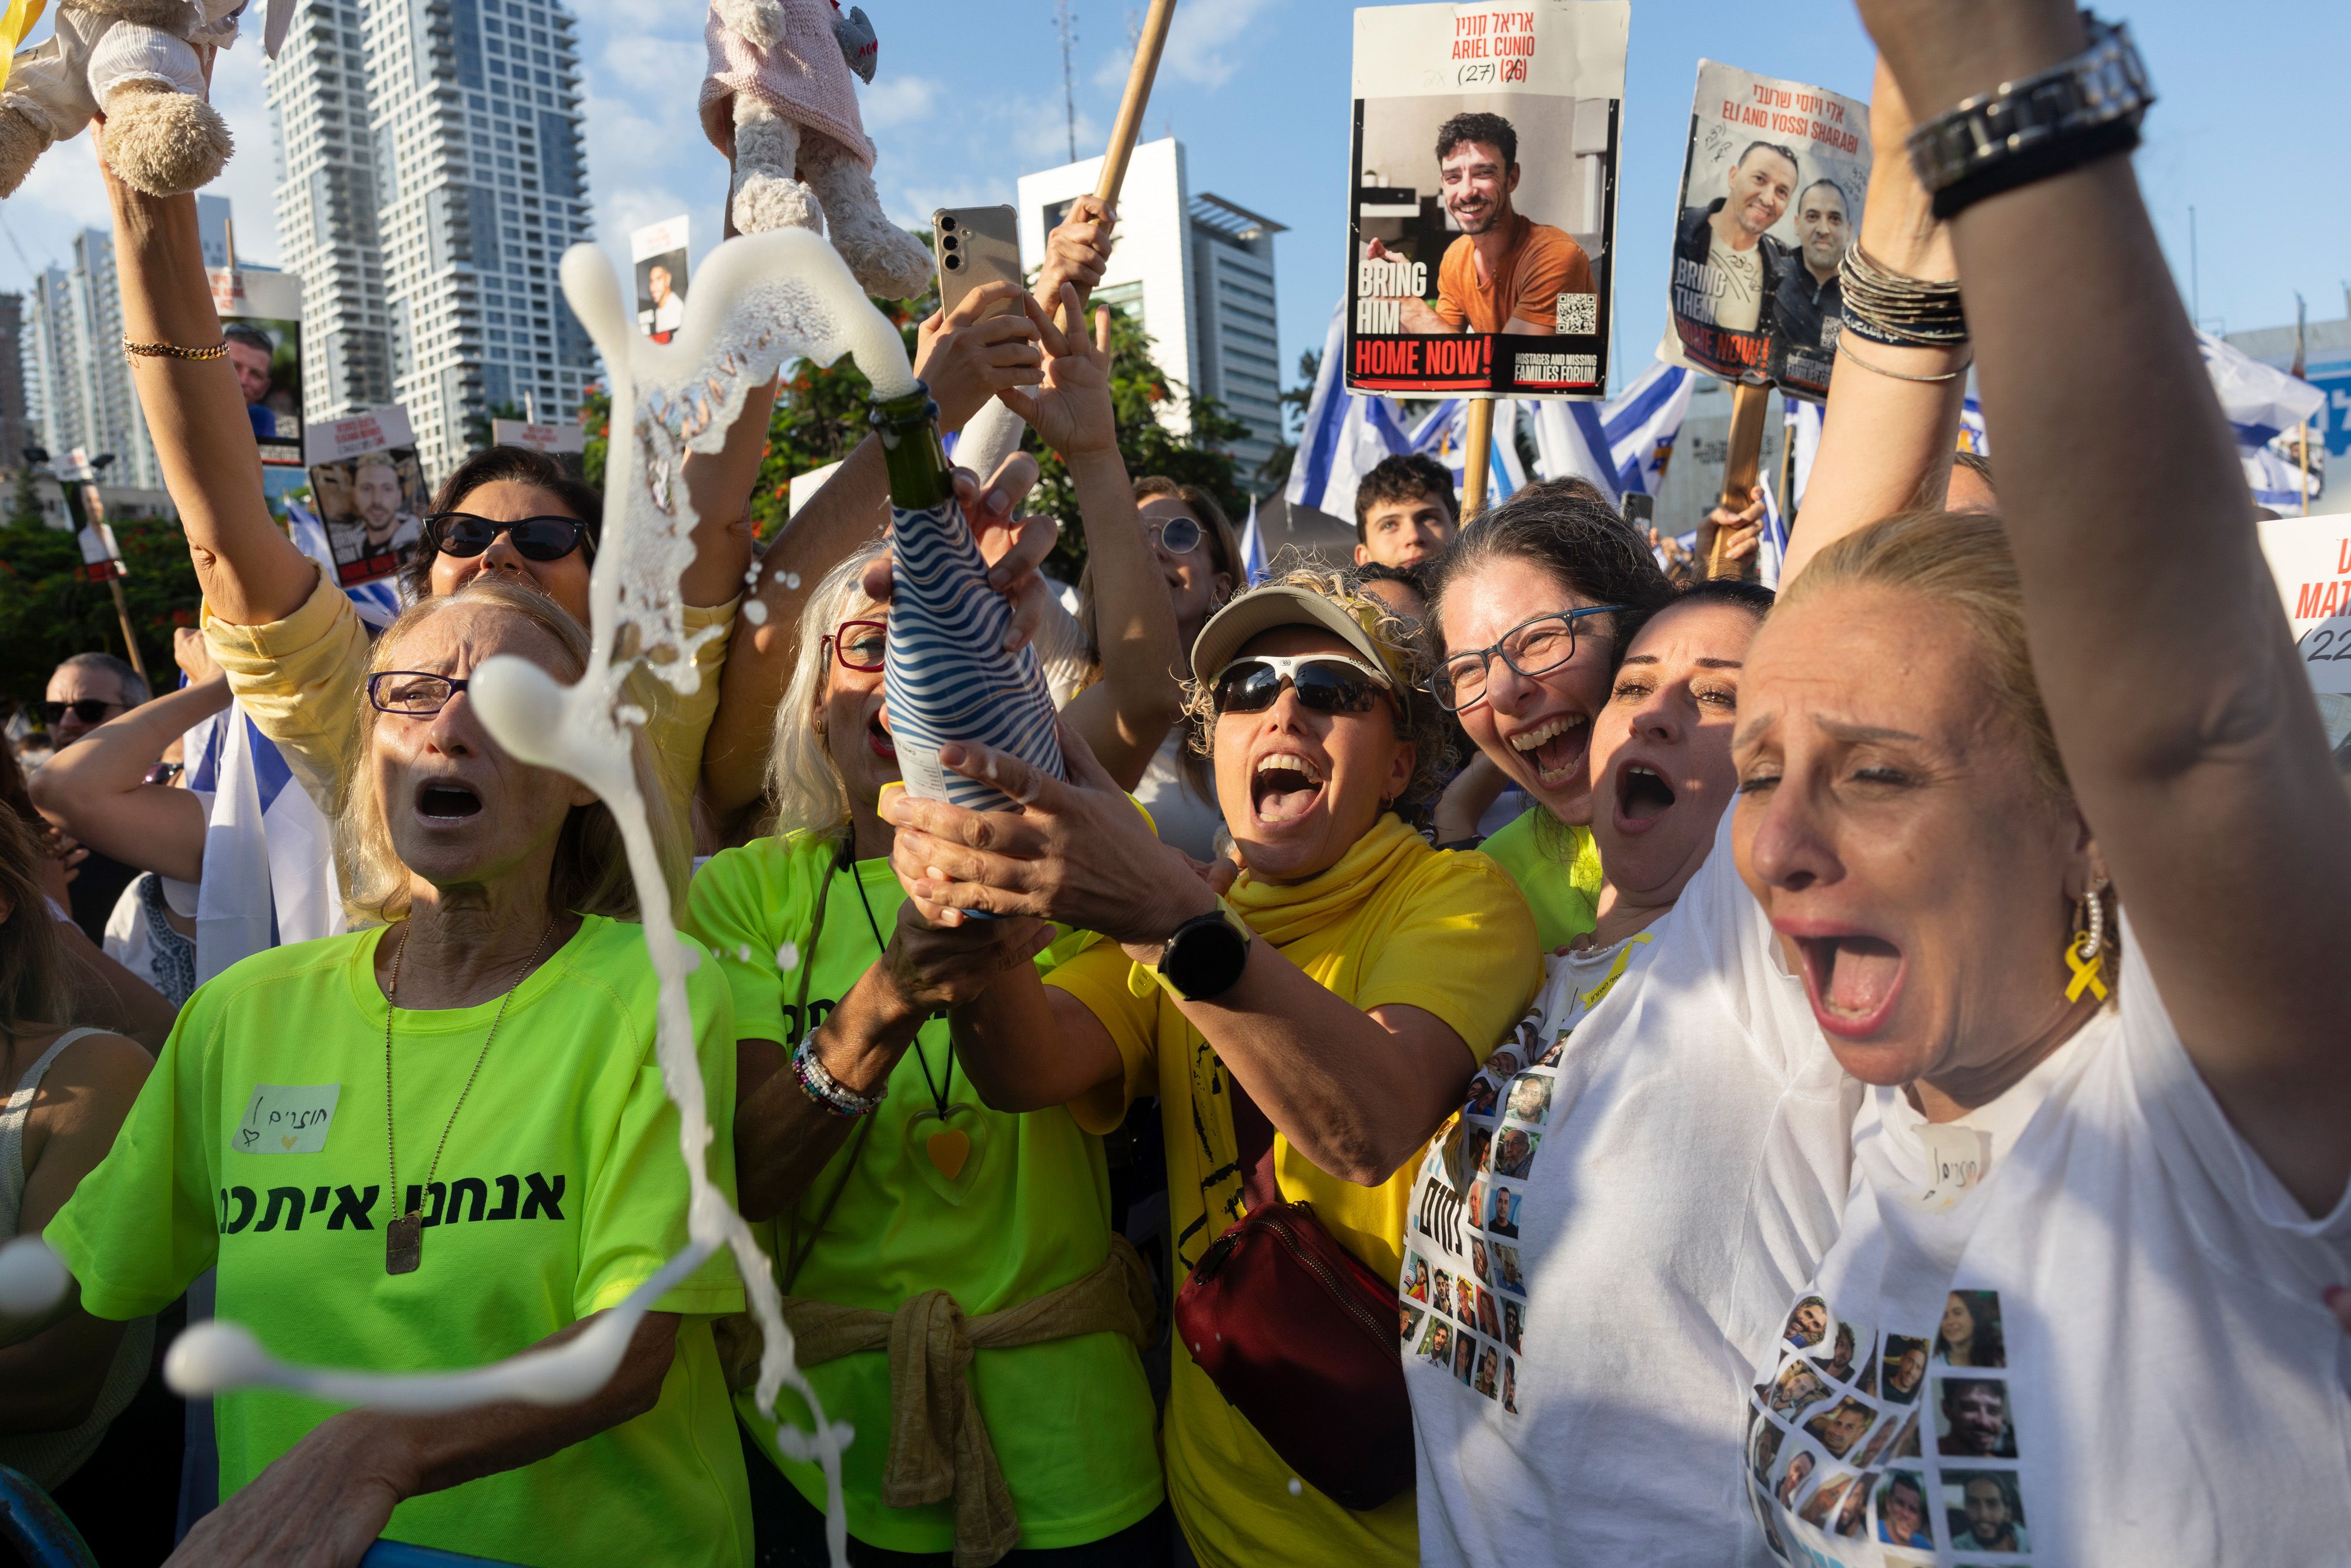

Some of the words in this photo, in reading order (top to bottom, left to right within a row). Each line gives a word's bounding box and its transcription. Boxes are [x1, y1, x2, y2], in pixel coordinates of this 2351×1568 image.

[1456, 15, 1487, 36] קוניו
[1492, 12, 1533, 33] אריאל
[1452, 38, 1489, 59] ARIEL
[1494, 36, 1535, 56] CUNIO
[1458, 63, 1495, 85] (27)
[1501, 59, 1527, 83] (26)
[1754, 84, 1791, 109] שרעבי
[1796, 93, 1823, 116] ויוסי
[1826, 100, 1845, 125] אלי
[1722, 100, 1740, 122] ELI
[1742, 107, 1767, 128] AND
[1772, 113, 1808, 136] YOSSI
[1811, 122, 1859, 155] SHARABI
[1358, 259, 1427, 297] BRING
[1675, 257, 1727, 298] BRING
[1357, 300, 1401, 334] HIM
[1676, 286, 1717, 325] THEM
[1355, 340, 1420, 375] HOME
[1425, 336, 1493, 375] NOW!
[1515, 353, 1550, 365] HOSTAGES
[1550, 354, 1565, 366] AND
[1566, 354, 1598, 366] MISSING
[1716, 333, 1770, 368] NOW!
[1515, 364, 1559, 381] FAMILIES
[1560, 366, 1597, 383] FORUM
[2295, 580, 2351, 619] MAT
[404, 1171, 565, 1228] אנחנו
